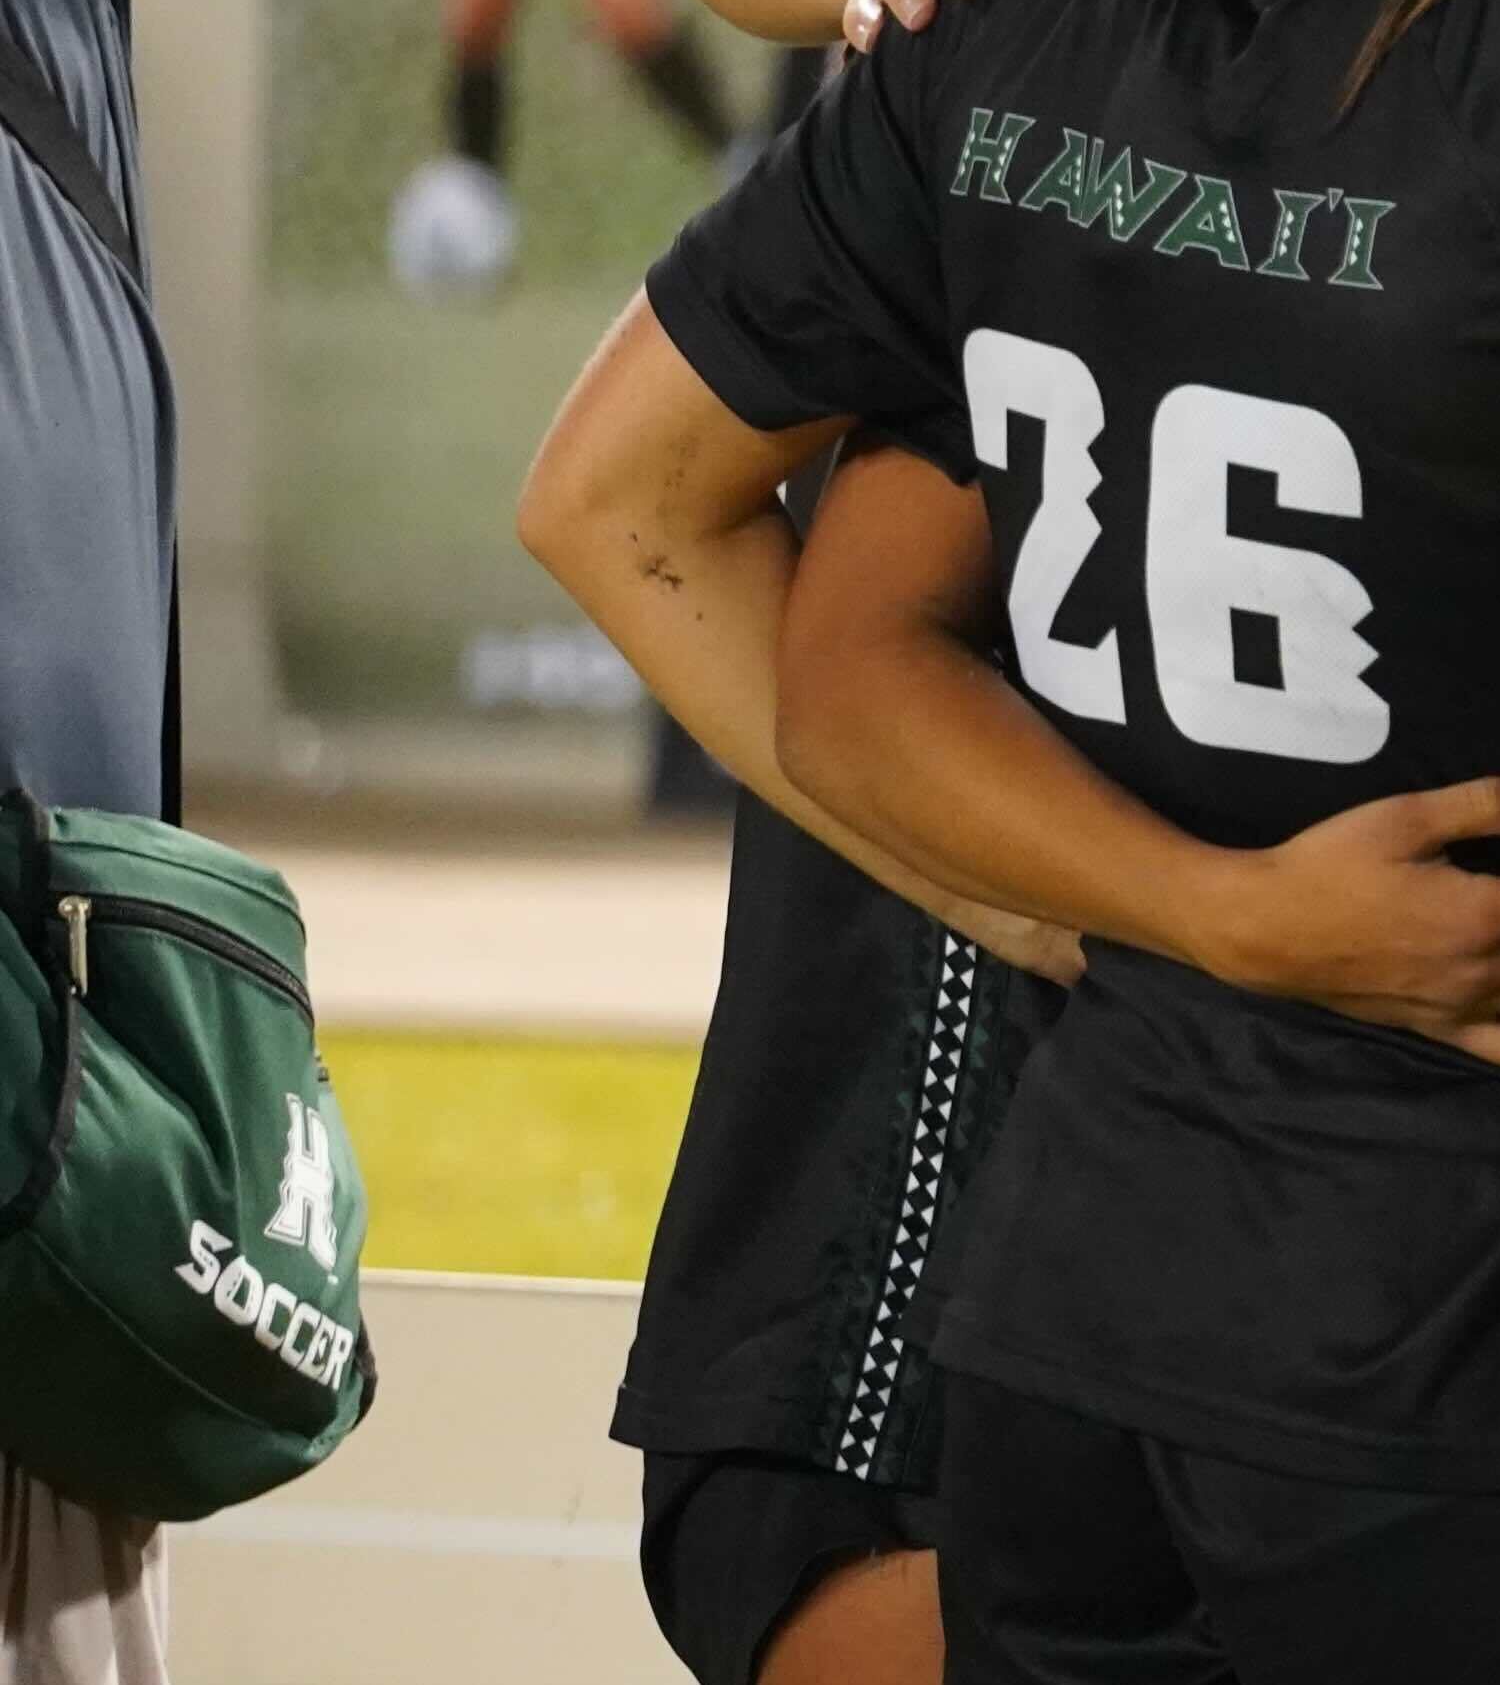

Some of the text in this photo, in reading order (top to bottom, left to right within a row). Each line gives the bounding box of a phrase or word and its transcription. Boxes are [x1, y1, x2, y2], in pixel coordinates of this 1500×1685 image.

[950, 108, 1396, 290] HAWAI'I
[963, 327, 1391, 764] 26
[264, 1092, 337, 1272] H
[175, 1219, 354, 1391] SOCCER
